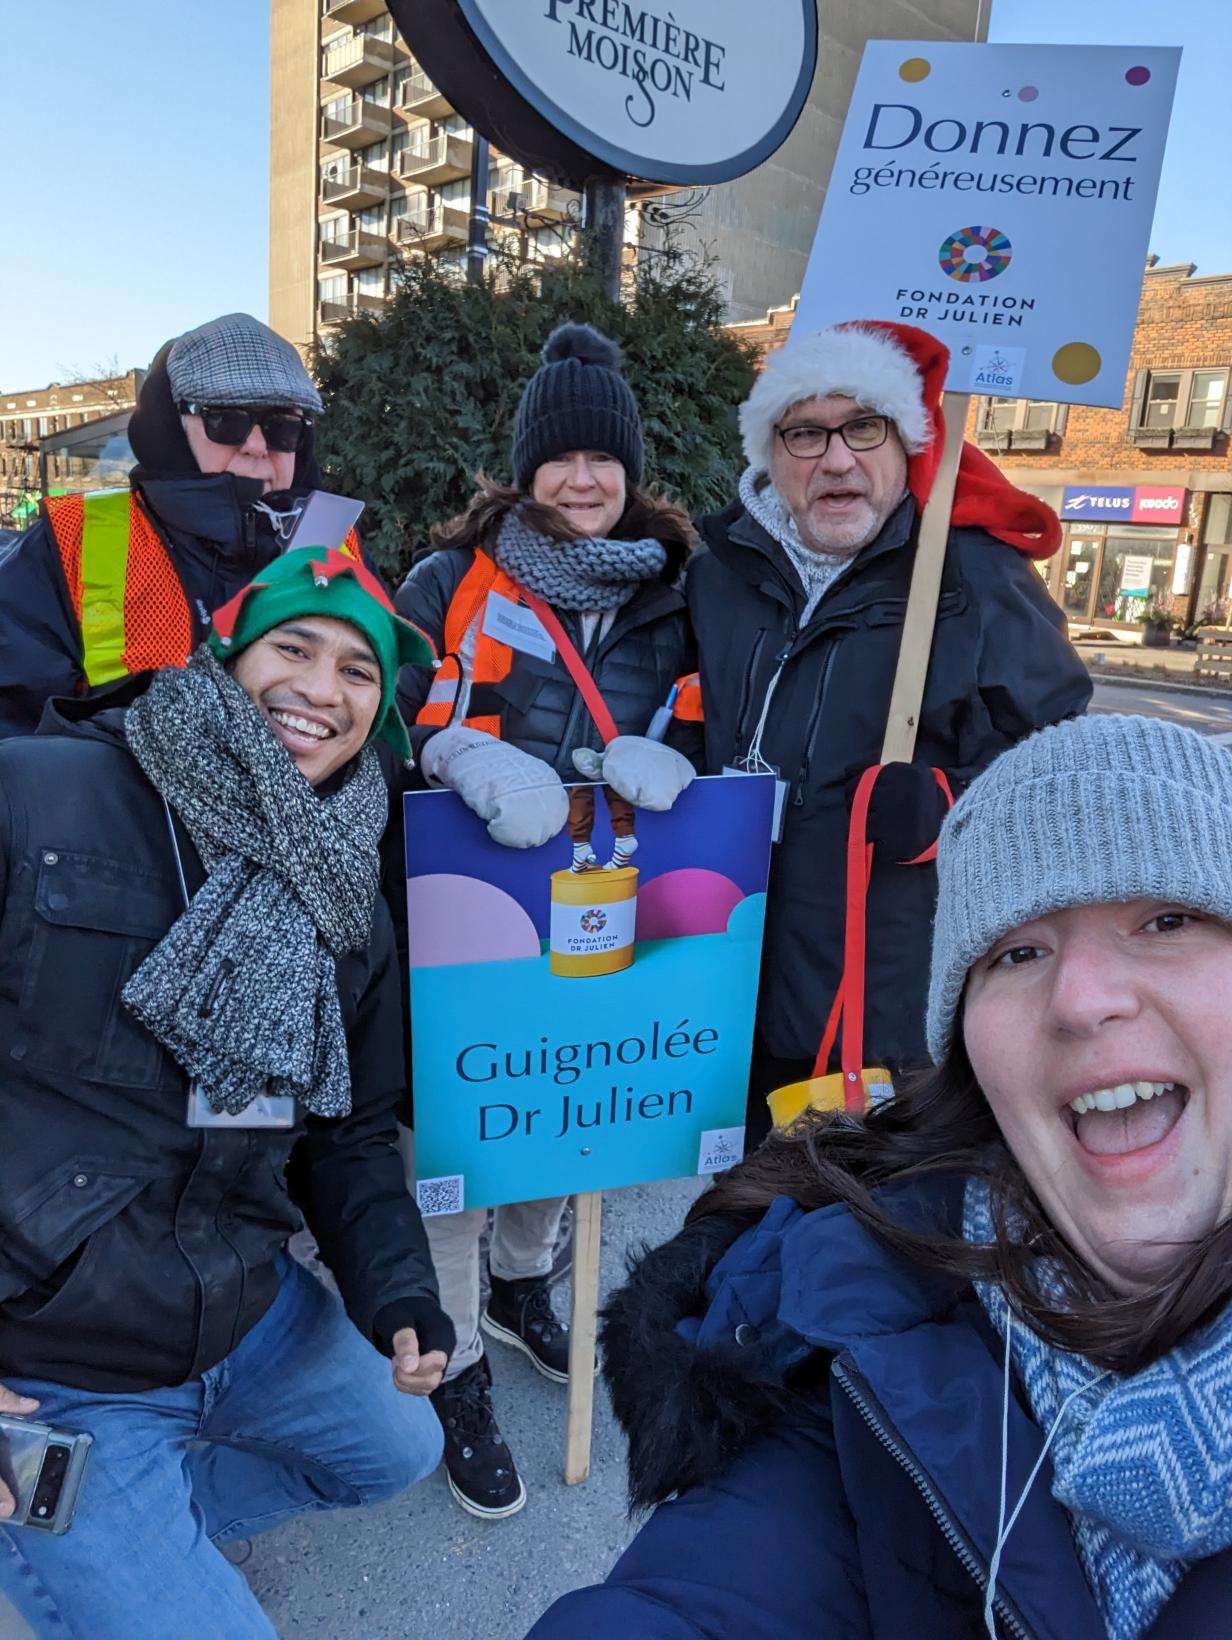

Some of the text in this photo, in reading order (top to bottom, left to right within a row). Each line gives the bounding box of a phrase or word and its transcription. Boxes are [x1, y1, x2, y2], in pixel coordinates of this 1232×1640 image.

[567, 20, 694, 127] MOISON
[862, 103, 1143, 162] Donnez
[850, 160, 1135, 201] généreusement
[896, 289, 1035, 310] FONDATION
[900, 306, 1024, 327] DR JULIEN
[975, 372, 1013, 385] Atlas
[1090, 496, 1131, 509] TELUS
[568, 935, 618, 944] FONDATION
[584, 943, 615, 951] JULIEN
[456, 1018, 719, 1085] Guignolée
[479, 1086, 693, 1142] Dr Julien
[704, 1154, 738, 1166] Atlas
